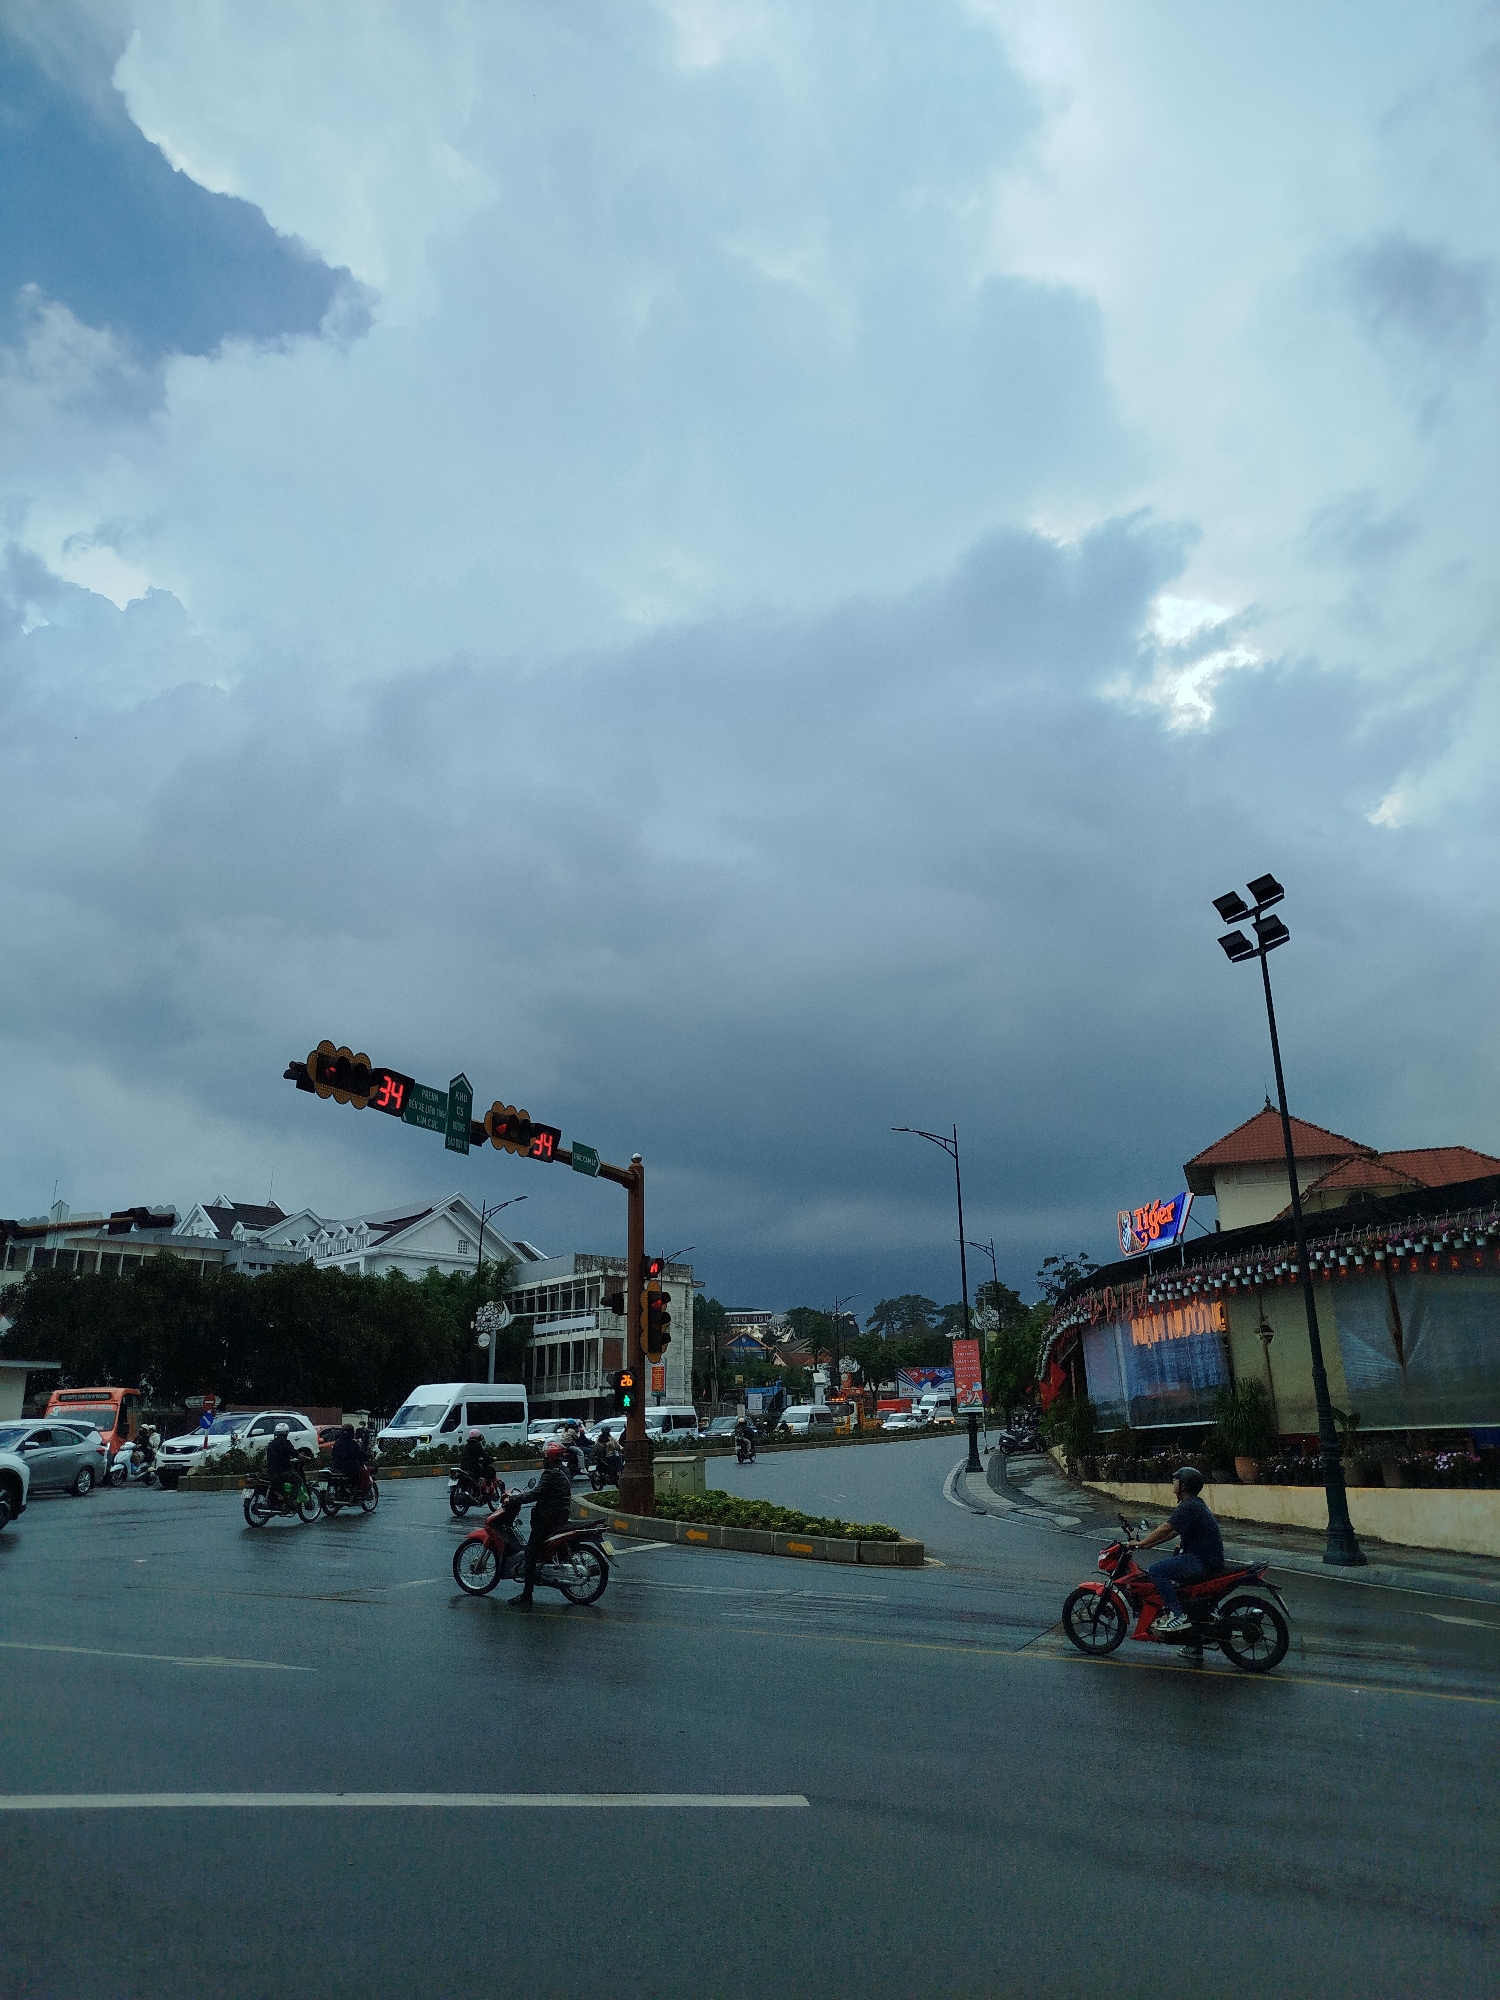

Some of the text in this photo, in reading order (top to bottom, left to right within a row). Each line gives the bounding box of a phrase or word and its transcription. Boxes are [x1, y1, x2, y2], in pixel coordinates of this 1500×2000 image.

[377, 1075, 404, 1109] 34
[455, 1091, 468, 1103] KHU
[533, 1133, 553, 1157] 34
[1134, 1199, 1175, 1240] Tiger
[620, 1374, 633, 1387] 26
